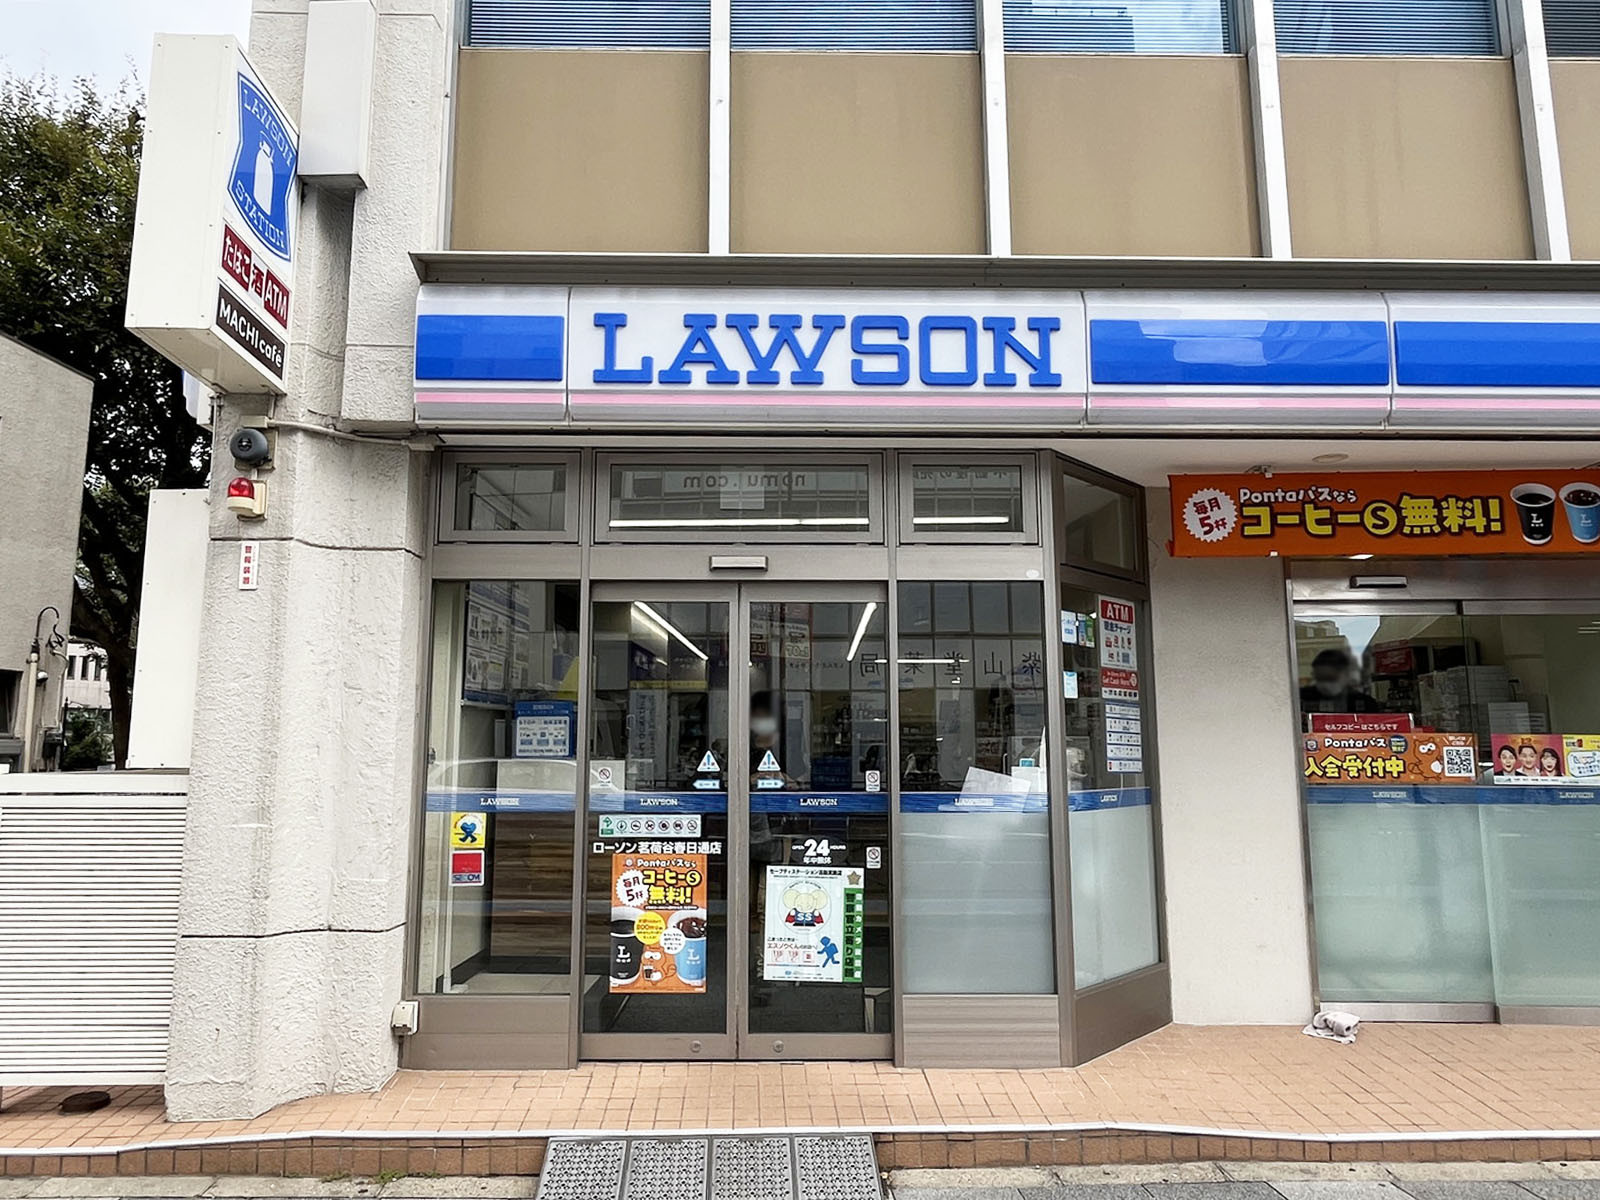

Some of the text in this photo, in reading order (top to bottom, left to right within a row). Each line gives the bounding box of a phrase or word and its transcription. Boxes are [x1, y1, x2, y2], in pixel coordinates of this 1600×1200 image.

[243, 89, 294, 167] LAWSON
[235, 179, 286, 249] STATION
[265, 279, 288, 321] ATM
[219, 298, 283, 368] MACHI café
[593, 312, 1062, 387] LAWSON
[1239, 486, 1358, 503] Pontaパスなら
[1193, 497, 1222, 516] 毎月
[1198, 515, 1228, 536] 5杯
[1106, 602, 1129, 621] ATM
[1324, 738, 1387, 748] Pontaパス
[1305, 754, 1404, 778] 入会受付中
[640, 798, 678, 806] LAWSON
[800, 798, 838, 806] LAWSON
[804, 838, 831, 857] 24
[646, 886, 691, 904] 無料!
